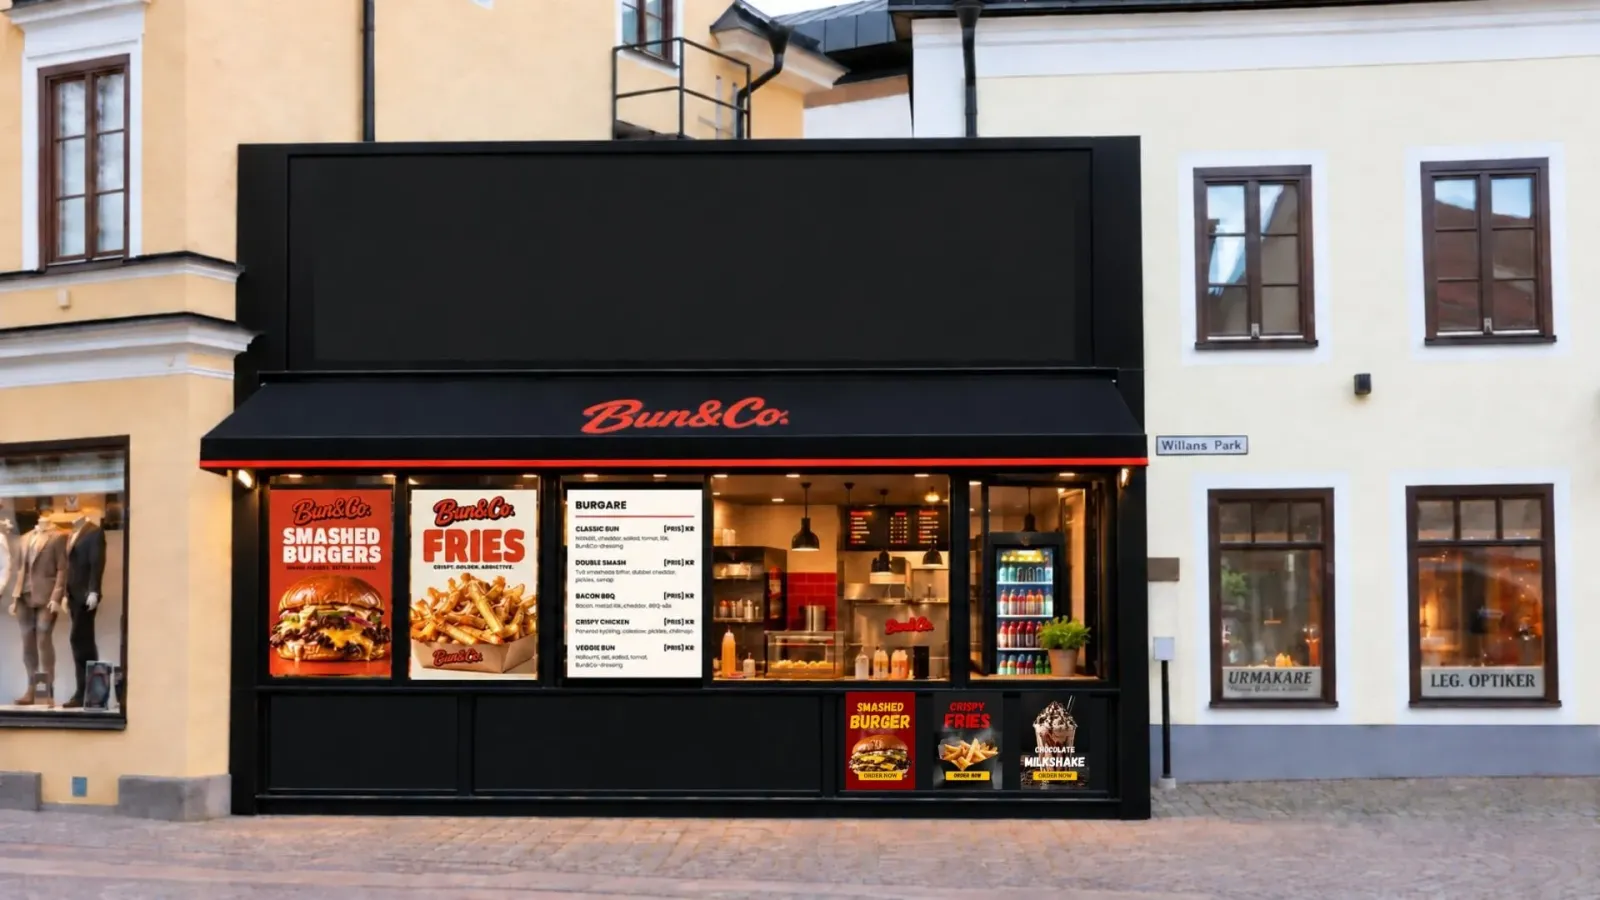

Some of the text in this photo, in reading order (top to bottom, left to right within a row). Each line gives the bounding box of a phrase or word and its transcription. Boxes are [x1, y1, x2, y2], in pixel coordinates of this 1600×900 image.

[1162, 440, 1242, 451] Willans Park
[575, 501, 627, 509] BURGARE
[283, 527, 380, 544] SMASHED
[423, 529, 525, 562] FRIES
[283, 546, 381, 563] BURGERS
[1228, 671, 1312, 684] URMAKARE
[1431, 673, 1536, 688] LEG. OPTIKER
[857, 702, 904, 712] SMASHED
[950, 702, 984, 711] CRISPY
[850, 714, 910, 729] BURGER
[944, 713, 990, 729] FRIES
[1025, 757, 1085, 767] MILKSHAKE
